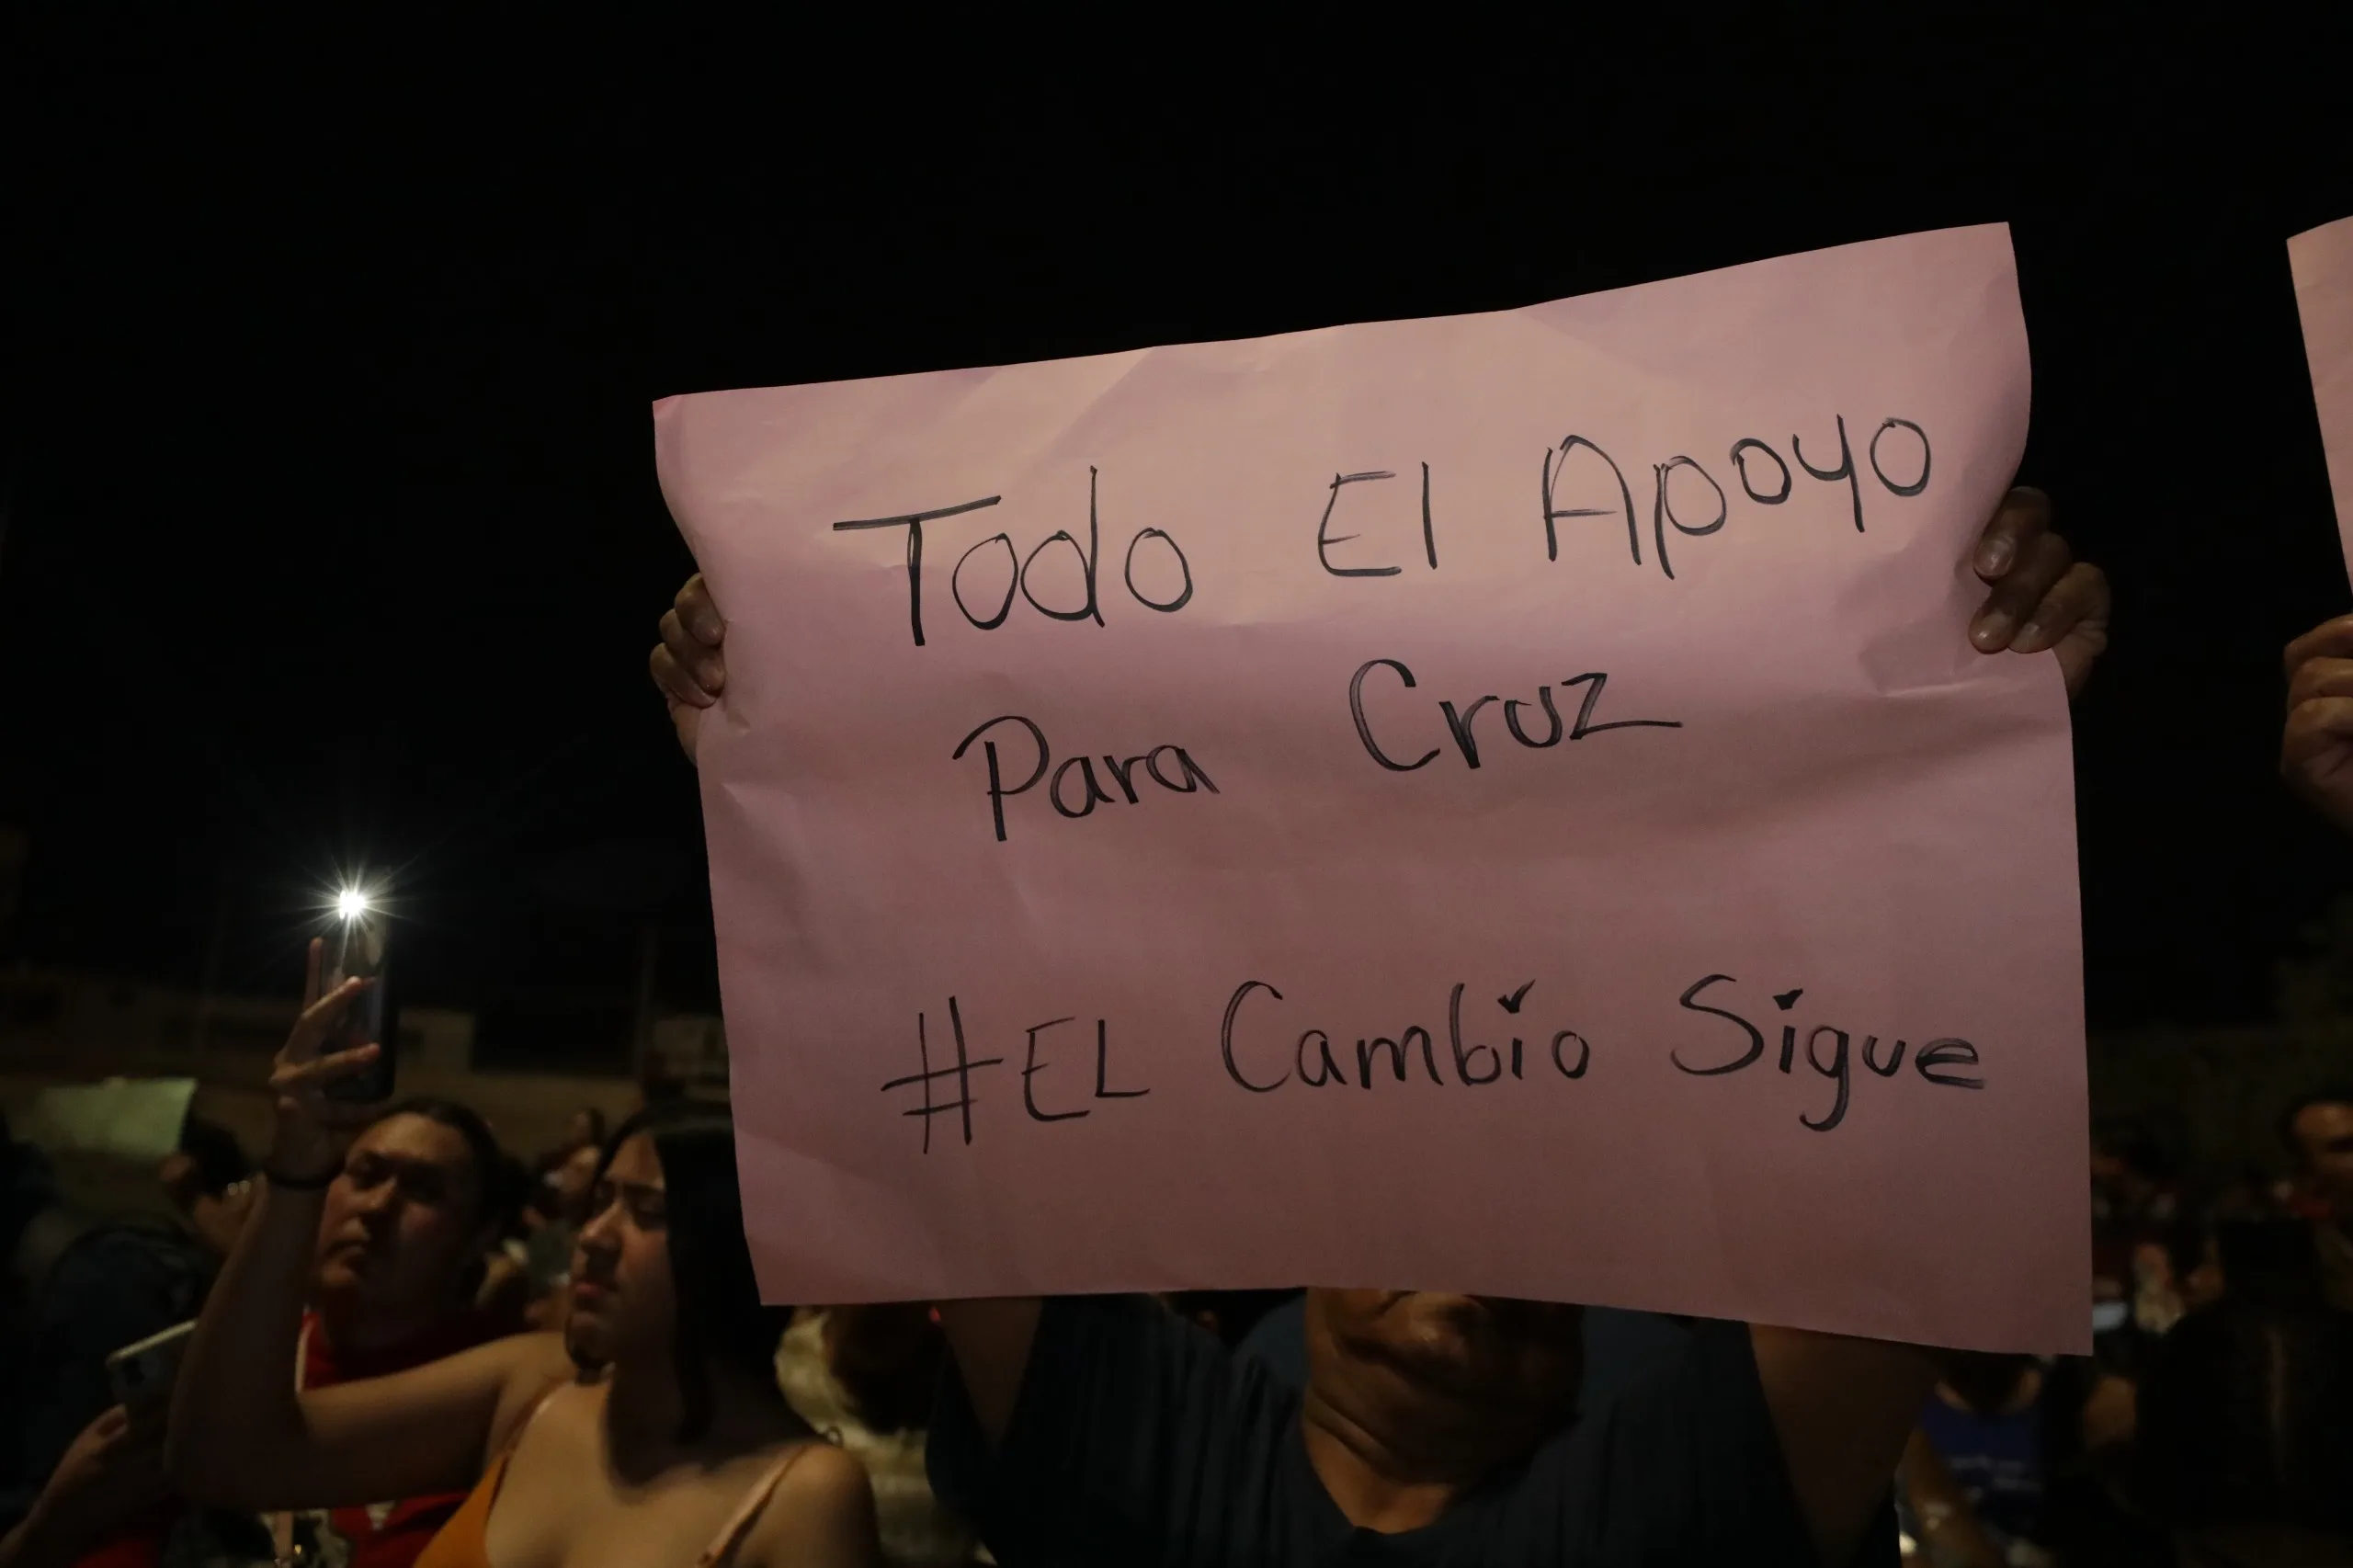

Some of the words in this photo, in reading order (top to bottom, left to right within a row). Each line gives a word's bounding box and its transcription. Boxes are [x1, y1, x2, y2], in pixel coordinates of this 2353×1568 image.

[833, 465, 1193, 647] Todo
[1318, 461, 1438, 578] El
[1541, 414, 1932, 581] Apoyo
[952, 716, 1220, 843] Para
[1349, 659, 1684, 771] Cruz
[881, 995, 1150, 1155] #EL
[1222, 980, 1589, 1093] Cambio
[1671, 974, 1984, 1132] Sigue
